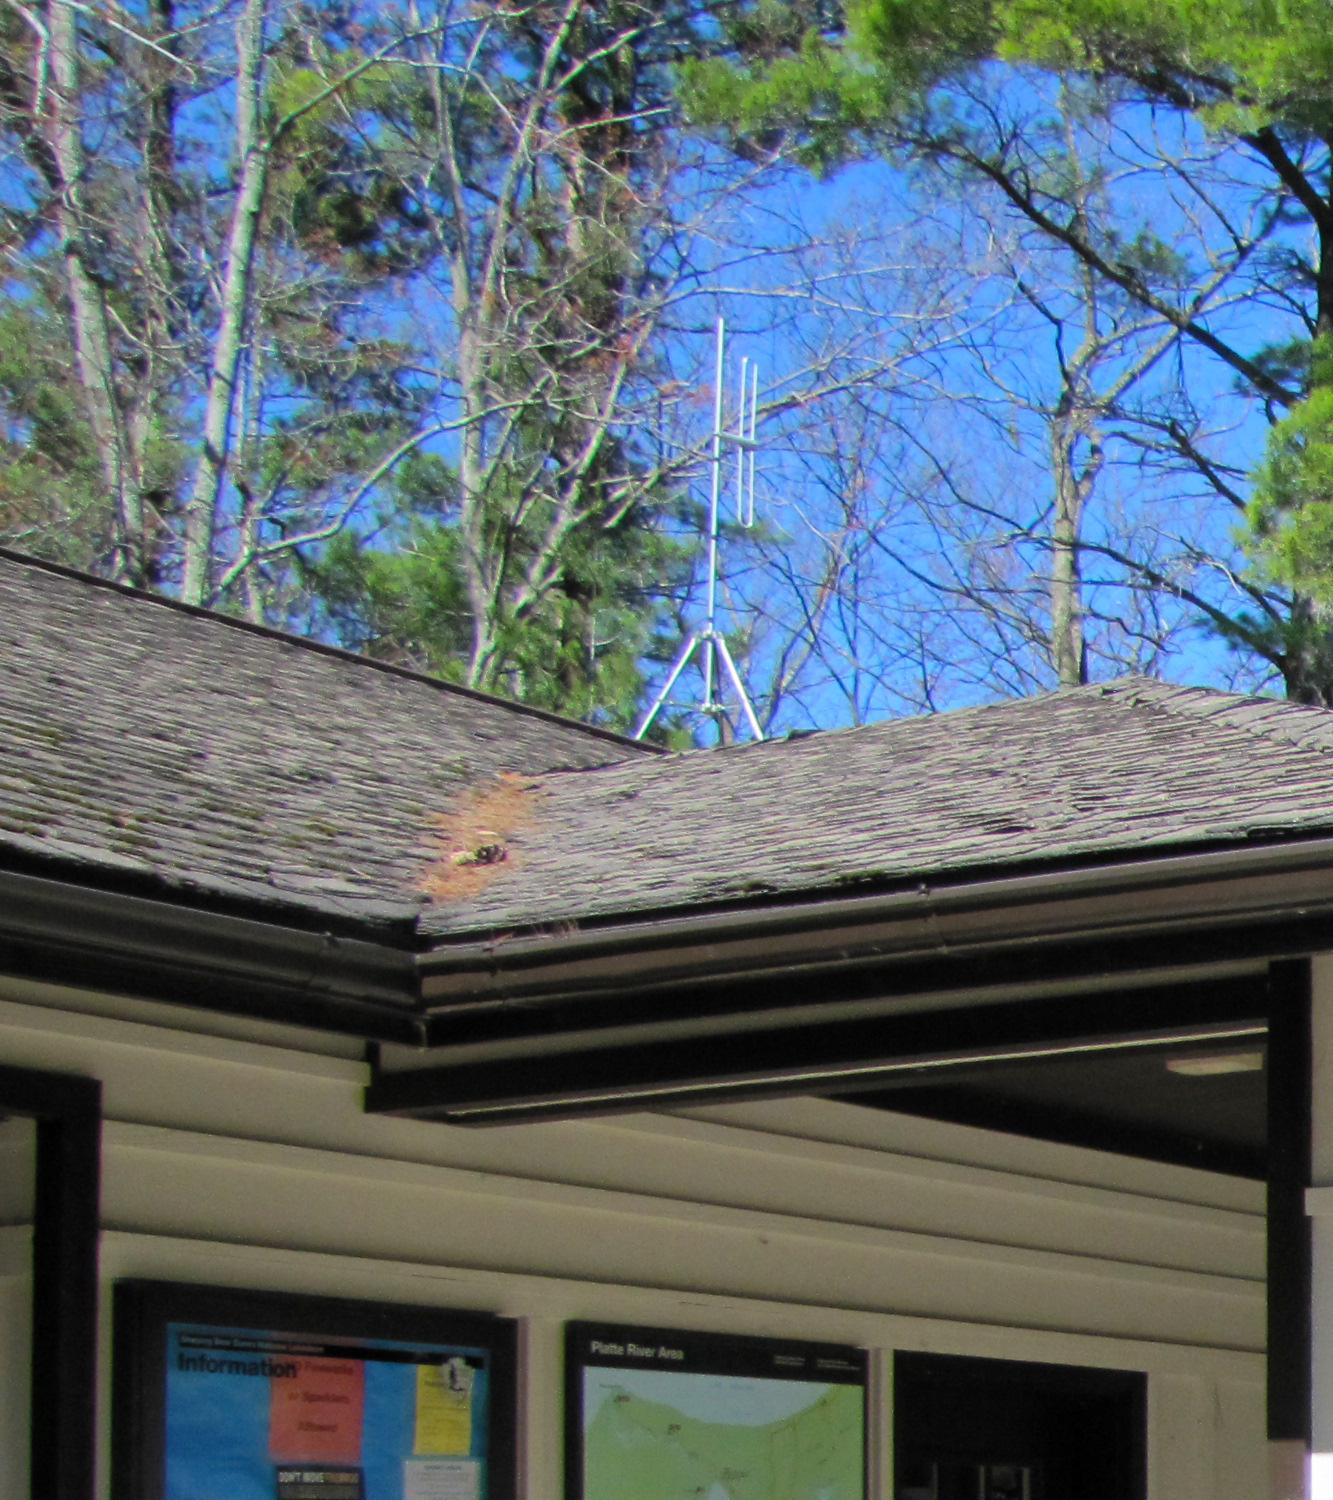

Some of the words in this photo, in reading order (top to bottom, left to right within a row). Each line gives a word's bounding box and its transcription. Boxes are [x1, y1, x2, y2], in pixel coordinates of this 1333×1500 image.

[591, 1340, 624, 1357] Platte
[627, 1343, 655, 1358] River
[658, 1346, 685, 1360] Area
[177, 1352, 297, 1379] Information
